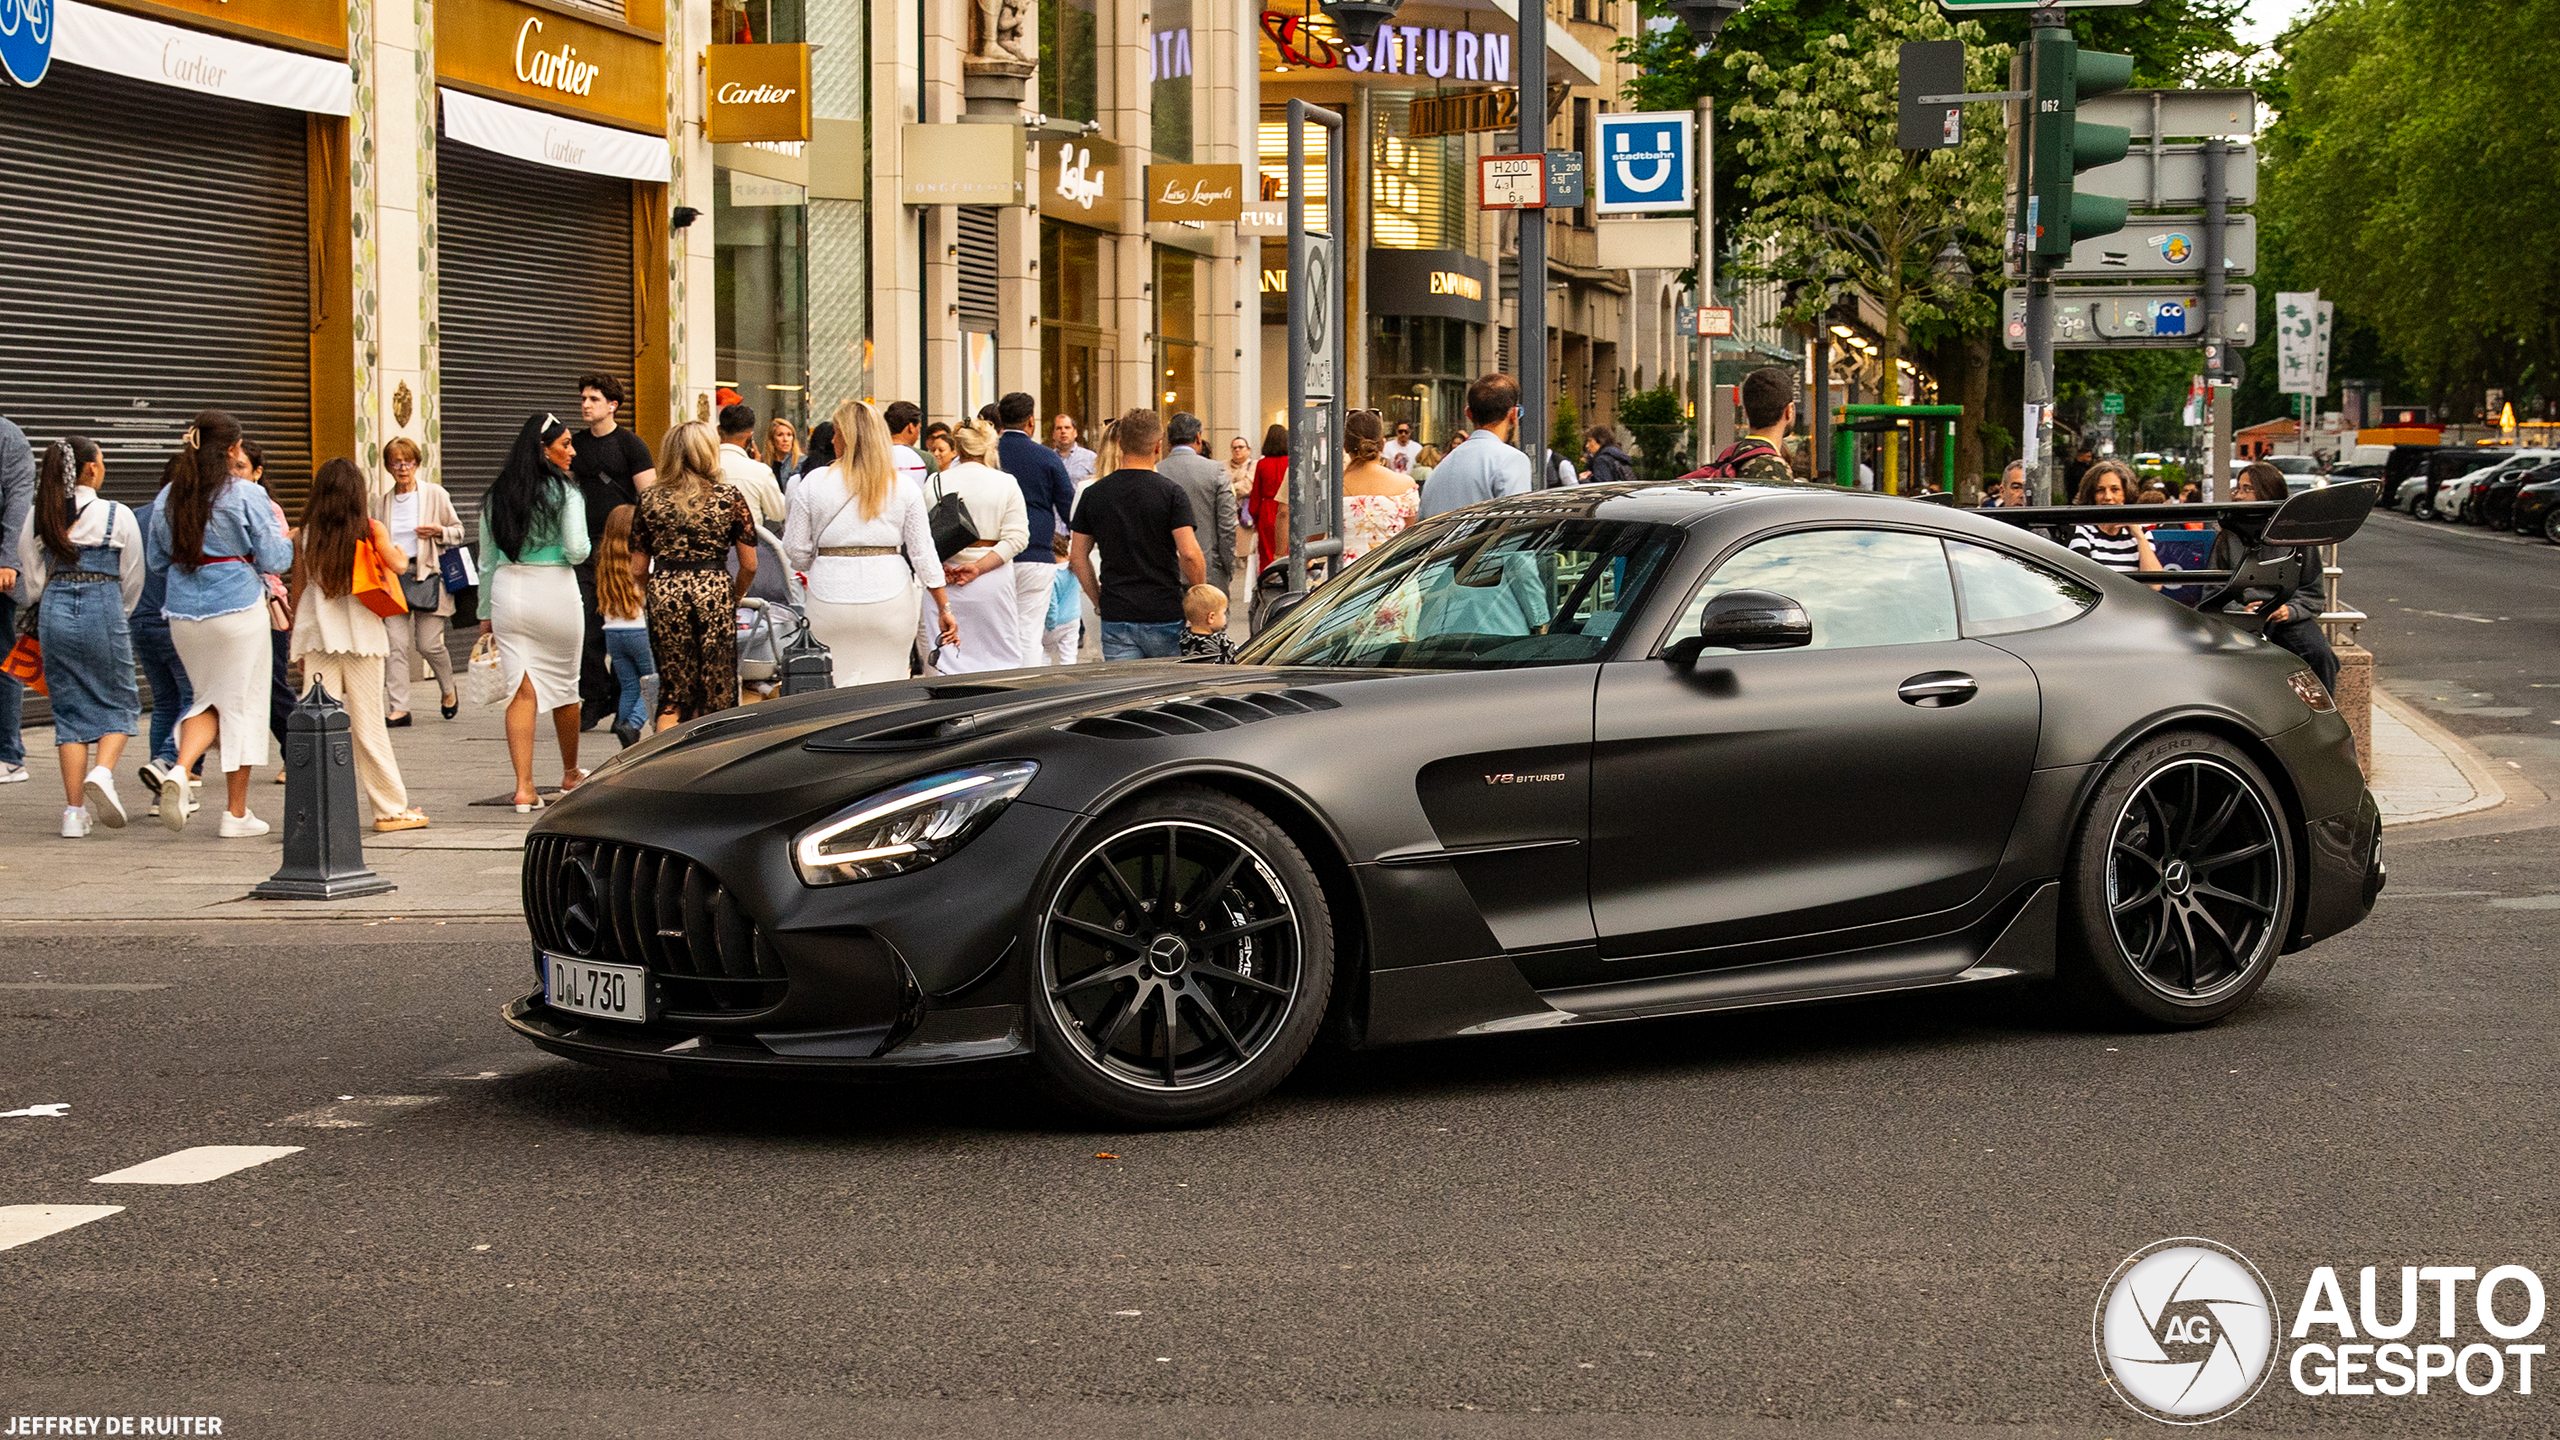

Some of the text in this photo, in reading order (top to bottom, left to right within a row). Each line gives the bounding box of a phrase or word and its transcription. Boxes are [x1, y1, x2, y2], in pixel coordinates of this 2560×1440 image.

[163, 37, 227, 88] Cartier
[515, 17, 599, 96] Cartier
[1346, 24, 1510, 82] SATURN
[717, 82, 796, 104] Cartier
[2041, 100, 2059, 112] 062
[544, 125, 586, 165] Cartier
[1612, 151, 1675, 161] stadtbahn
[1566, 163, 1582, 172] 200
[1158, 179, 1189, 205] Luisa
[1559, 186, 1571, 194] 6.8
[2144, 738, 2193, 758] ZERO
[1485, 773, 1565, 785] V8 BITURBO
[556, 962, 566, 1003] D
[587, 968, 626, 1012] 730
